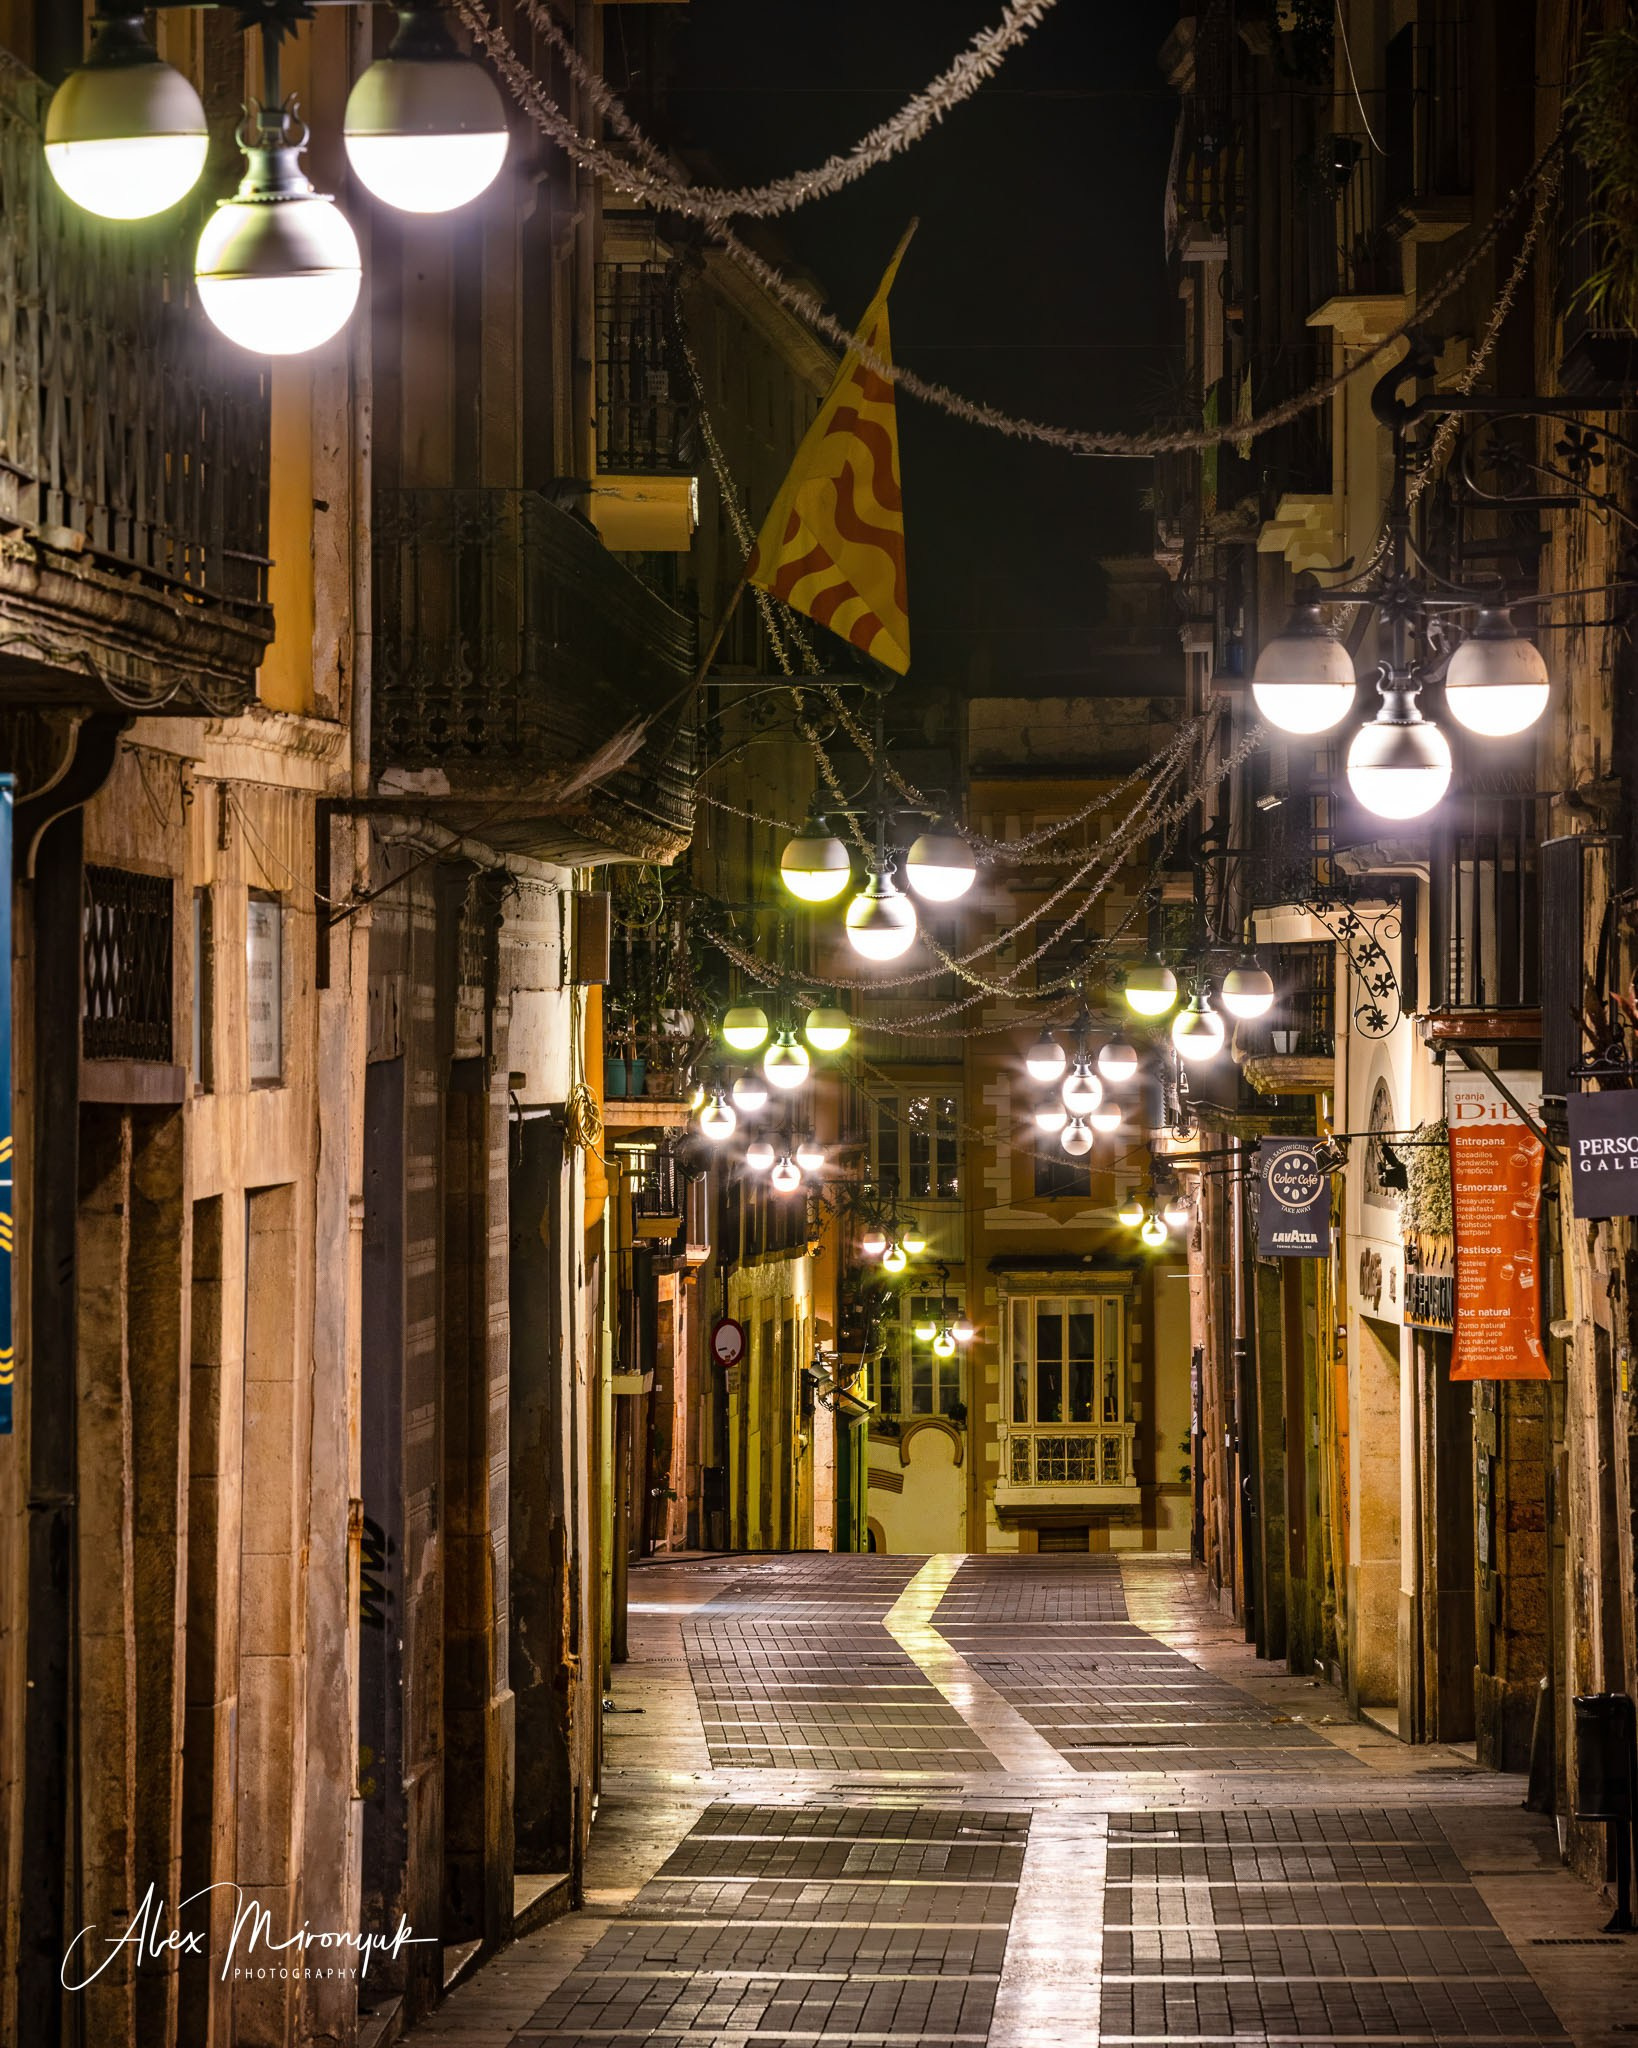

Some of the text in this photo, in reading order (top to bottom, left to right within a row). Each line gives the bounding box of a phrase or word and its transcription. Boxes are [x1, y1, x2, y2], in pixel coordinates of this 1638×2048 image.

[1455, 1092, 1485, 1101] granja
[1455, 1137, 1505, 1147] Entrepans
[1272, 1144, 1309, 1157] SANDWICHES
[1273, 1171, 1318, 1188] Color Café
[1456, 1183, 1508, 1192] Esmorzars
[1456, 1197, 1495, 1206] Desayunos
[1281, 1205, 1311, 1214] TAKE AWAY
[1272, 1230, 1319, 1243] LAVAZZA
[1457, 1245, 1502, 1254] Pastissos
[1458, 1308, 1511, 1316] Suc natural
